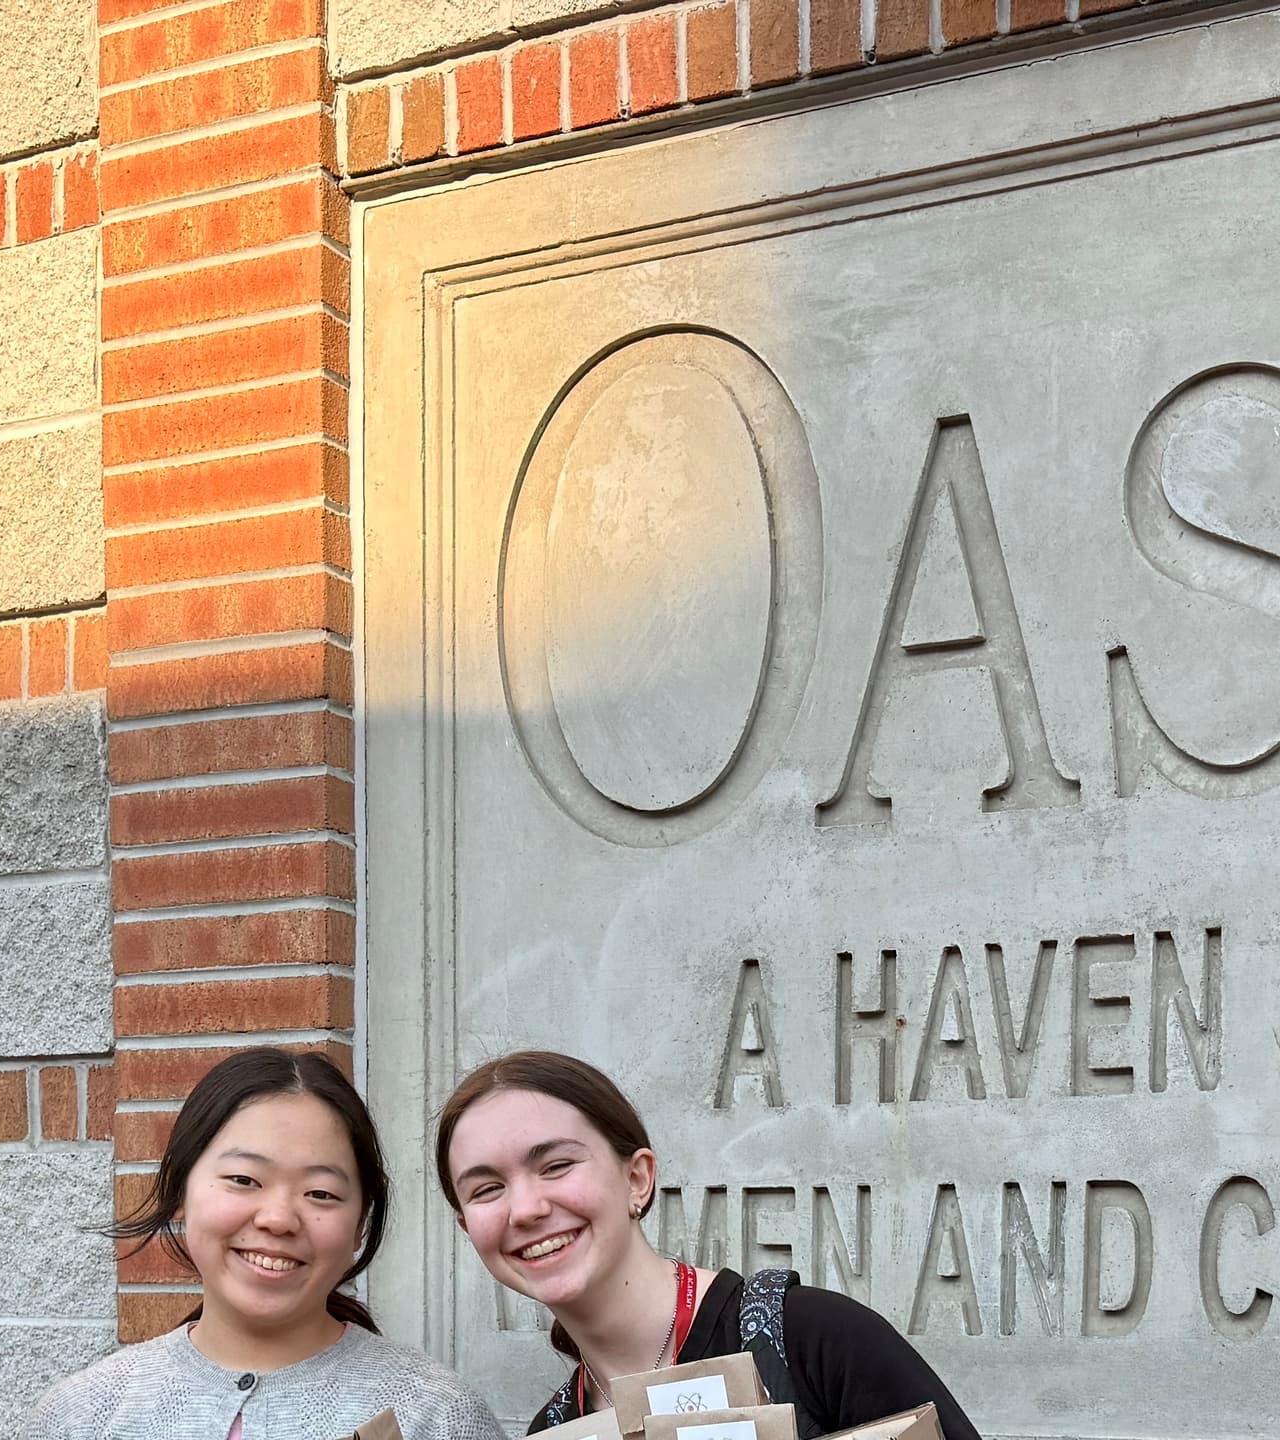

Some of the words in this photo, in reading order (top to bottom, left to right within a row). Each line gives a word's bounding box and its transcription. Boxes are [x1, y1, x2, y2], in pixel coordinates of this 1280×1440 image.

[714, 958, 785, 1110] A
[833, 927, 1224, 1106] HAVEN
[907, 1180, 1154, 1337] AND
